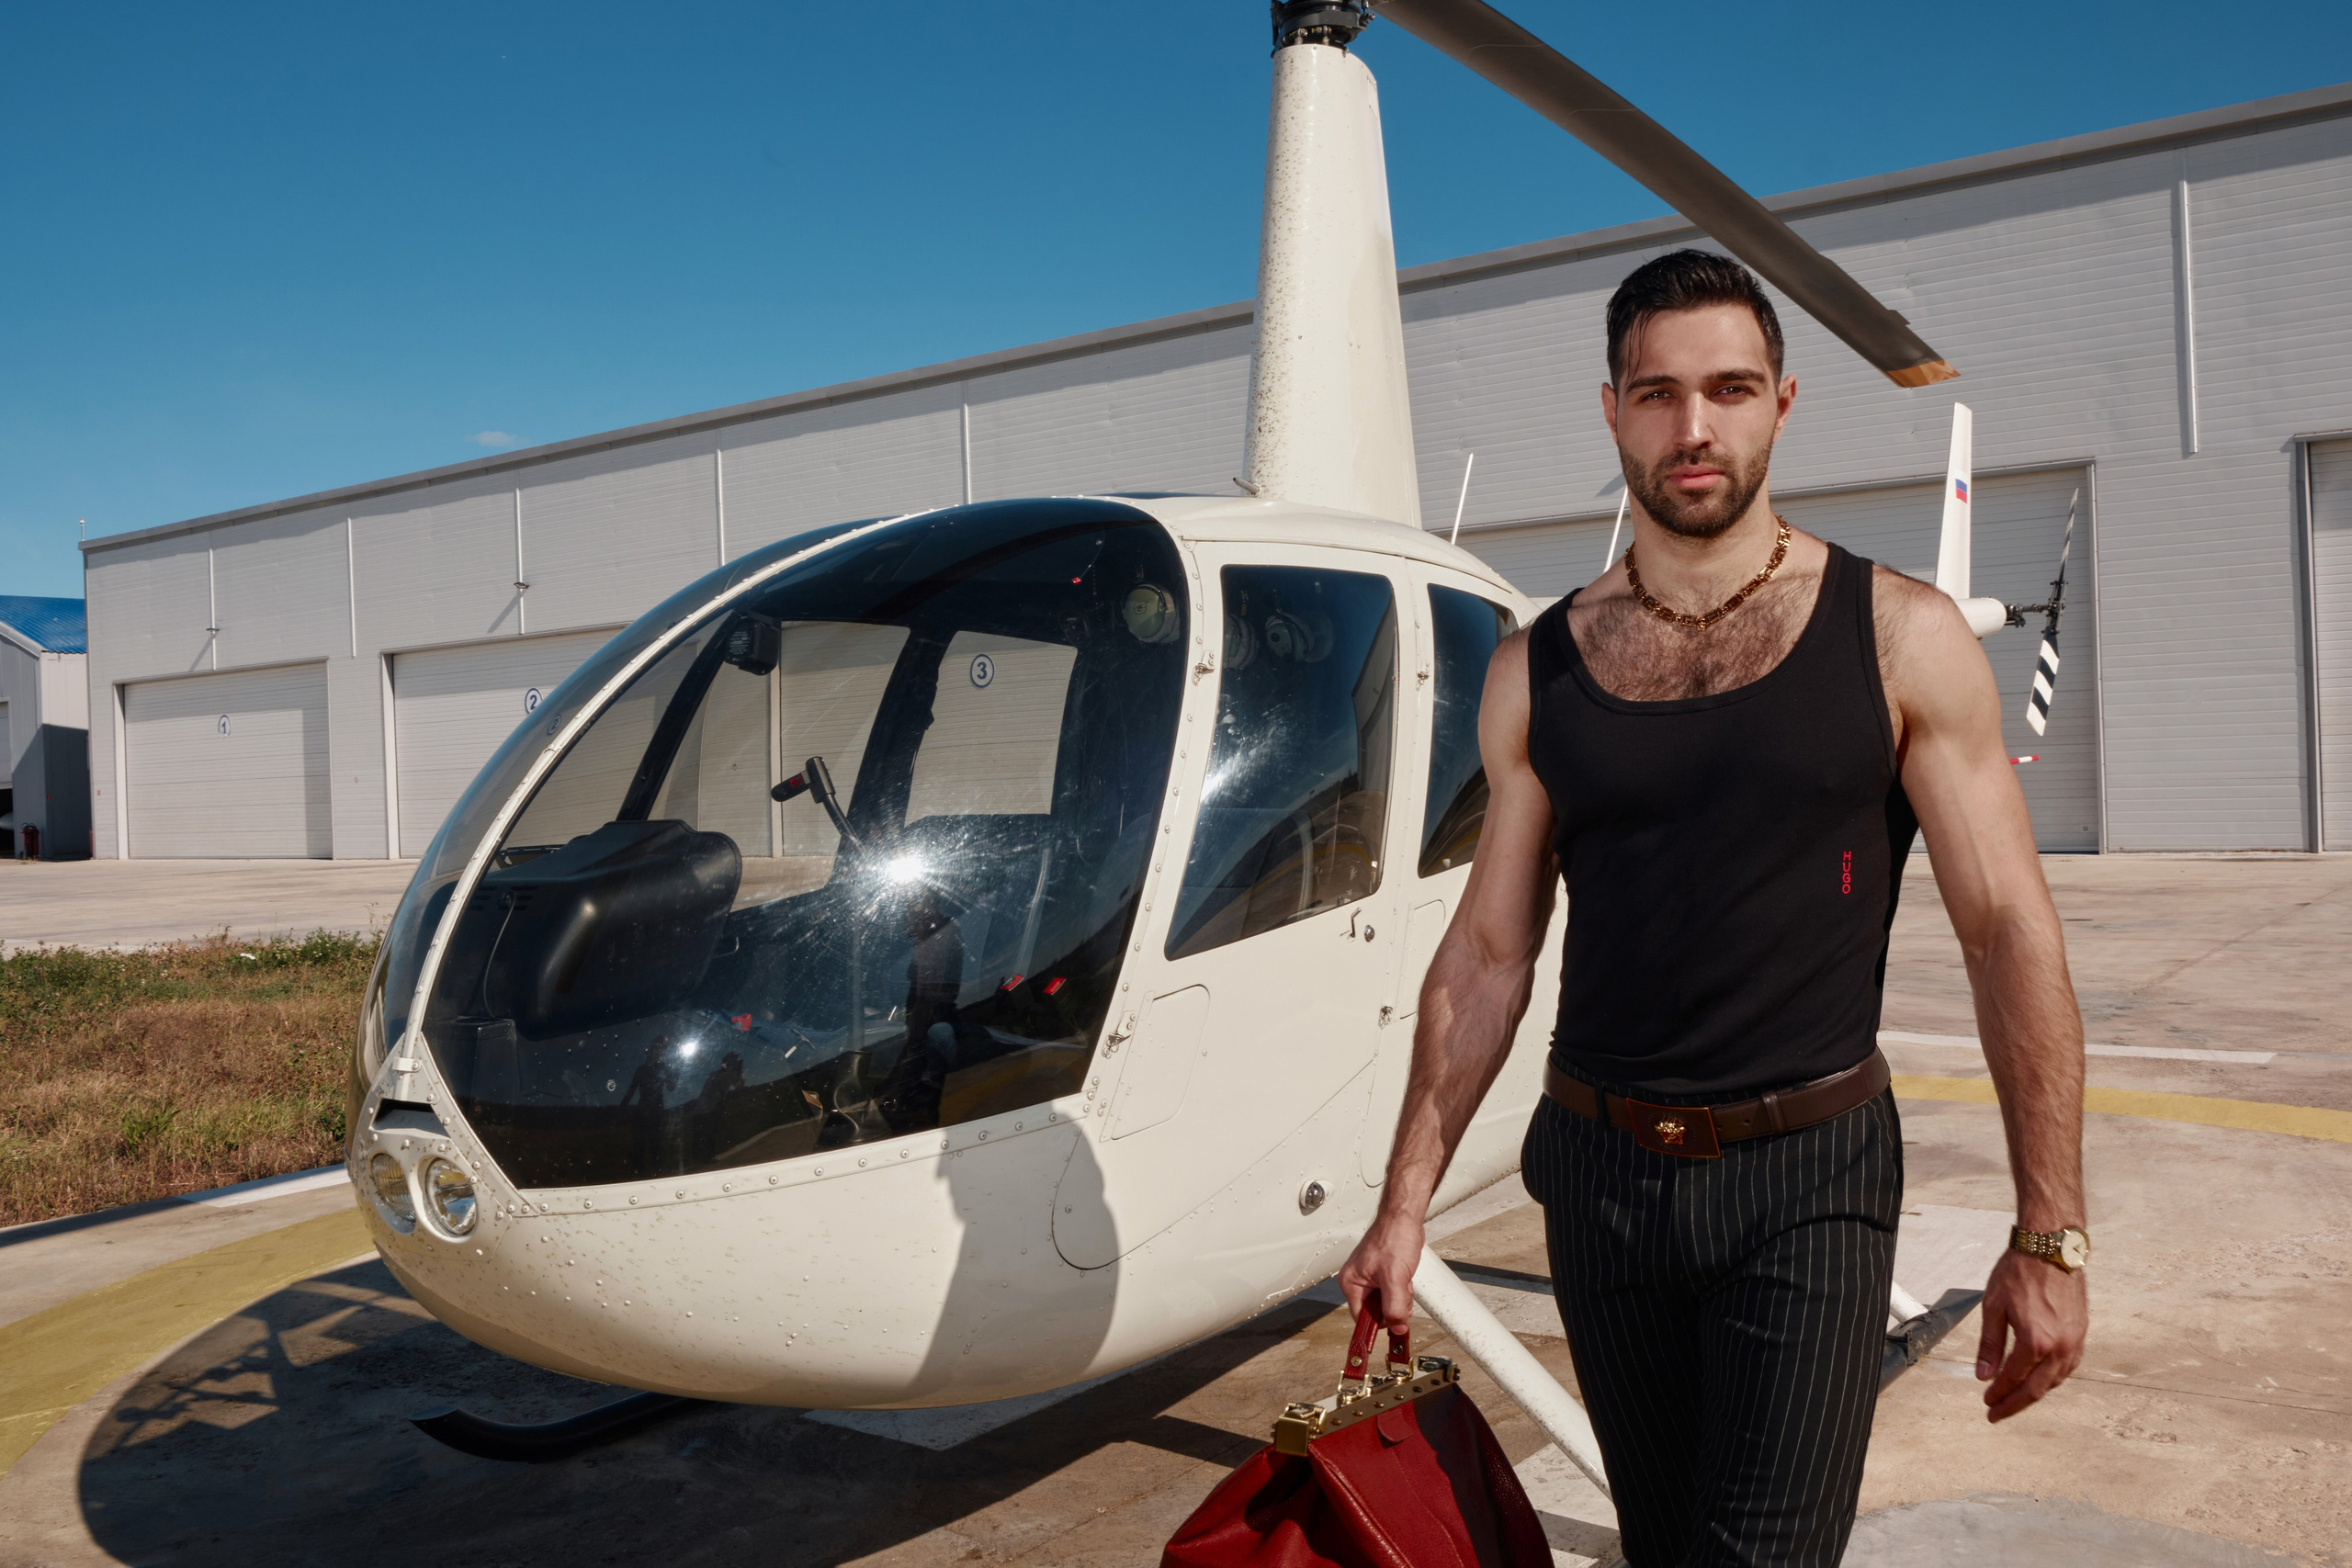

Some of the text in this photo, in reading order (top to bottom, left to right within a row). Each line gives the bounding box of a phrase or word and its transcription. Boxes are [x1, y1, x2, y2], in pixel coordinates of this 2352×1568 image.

[977, 661, 988, 680] 3
[529, 694, 537, 710] 2
[1842, 851, 1852, 895] HUGO
